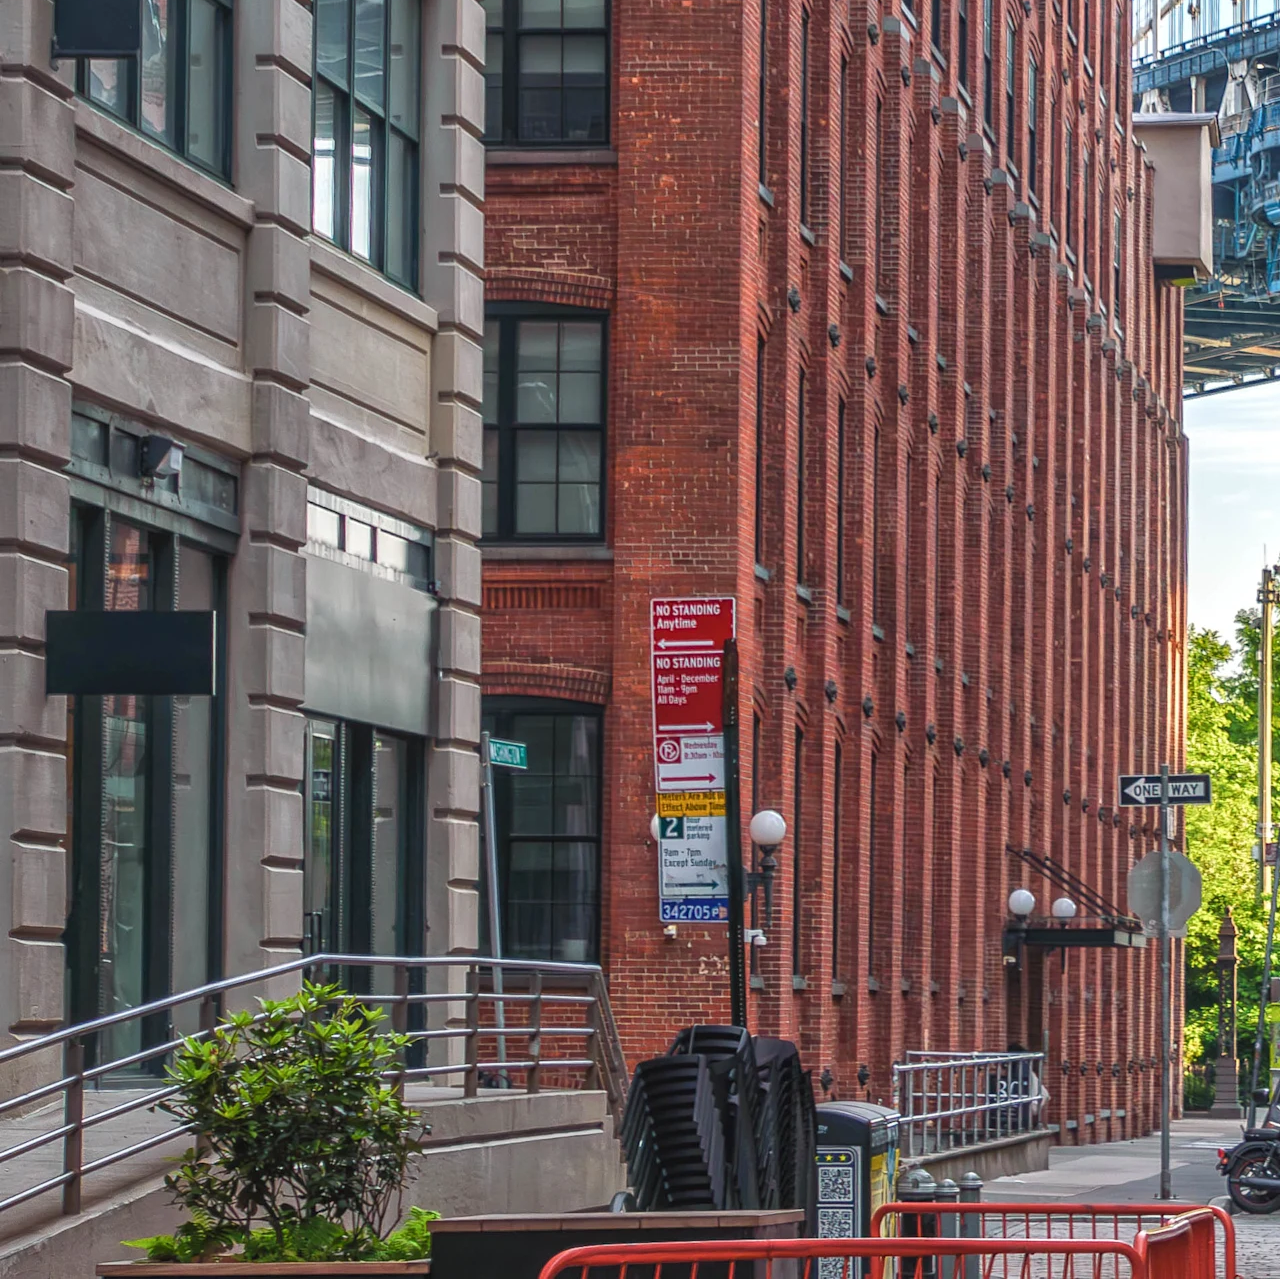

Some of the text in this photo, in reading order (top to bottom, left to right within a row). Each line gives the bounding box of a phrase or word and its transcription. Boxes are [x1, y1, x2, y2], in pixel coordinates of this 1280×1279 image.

[656, 604, 721, 616] NO STANDING
[657, 618, 697, 631] Anytime
[656, 657, 721, 669] NO STANDING
[657, 674, 675, 684] April
[681, 674, 719, 683] December
[657, 685, 675, 694] 11am
[681, 685, 698, 694] 9pm
[657, 695, 687, 705] All Days
[1134, 784, 1198, 796] ONE WAY
[662, 803, 683, 812] Effect
[685, 803, 708, 811] Above
[665, 817, 679, 837] 2
[686, 833, 710, 841] parking
[663, 848, 679, 857] 9am
[686, 847, 701, 857] 7pm
[663, 858, 717, 868] Except Sunday
[663, 905, 711, 919] 342705
